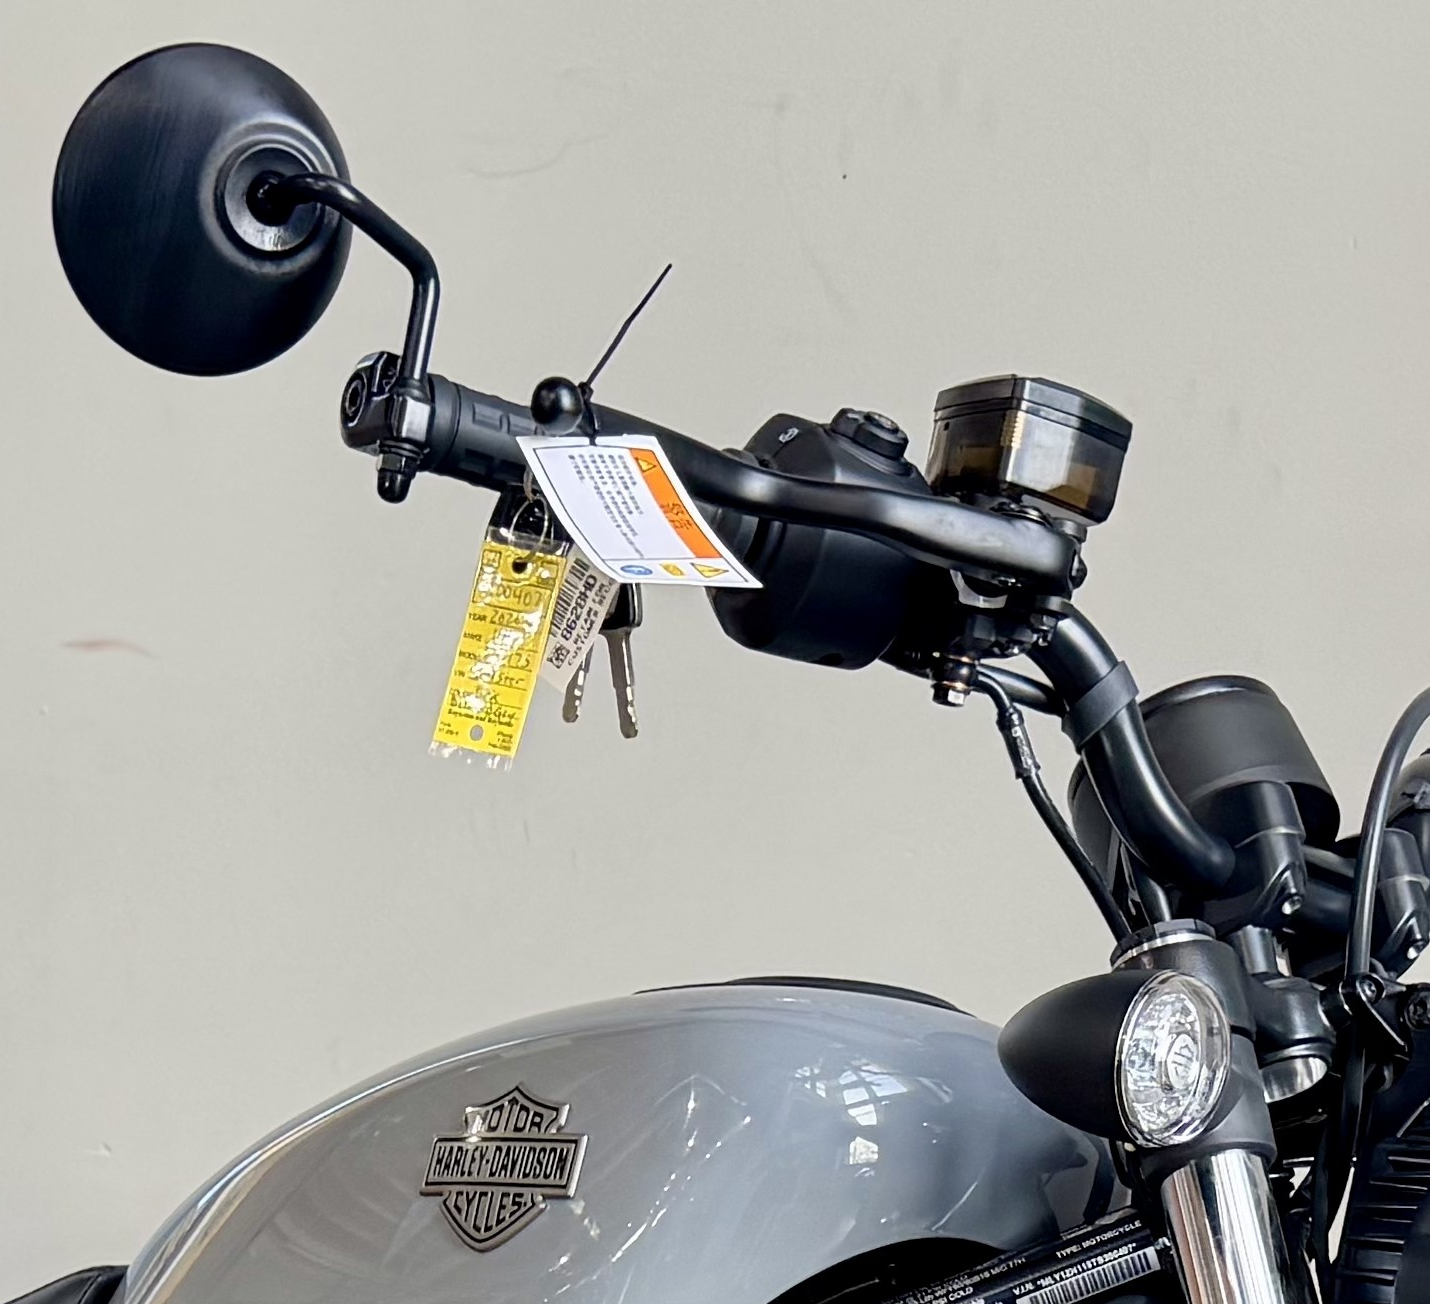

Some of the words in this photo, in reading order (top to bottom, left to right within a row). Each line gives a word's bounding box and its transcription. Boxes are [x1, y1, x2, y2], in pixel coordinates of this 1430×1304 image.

[560, 574, 598, 641] 8628HD
[433, 1145, 570, 1181] HARLEY-DAVIDSON
[452, 1190, 524, 1233] CYCLES
[1082, 1220, 1140, 1247] MOTORCYCLE
[949, 1287, 973, 1300] COLD
